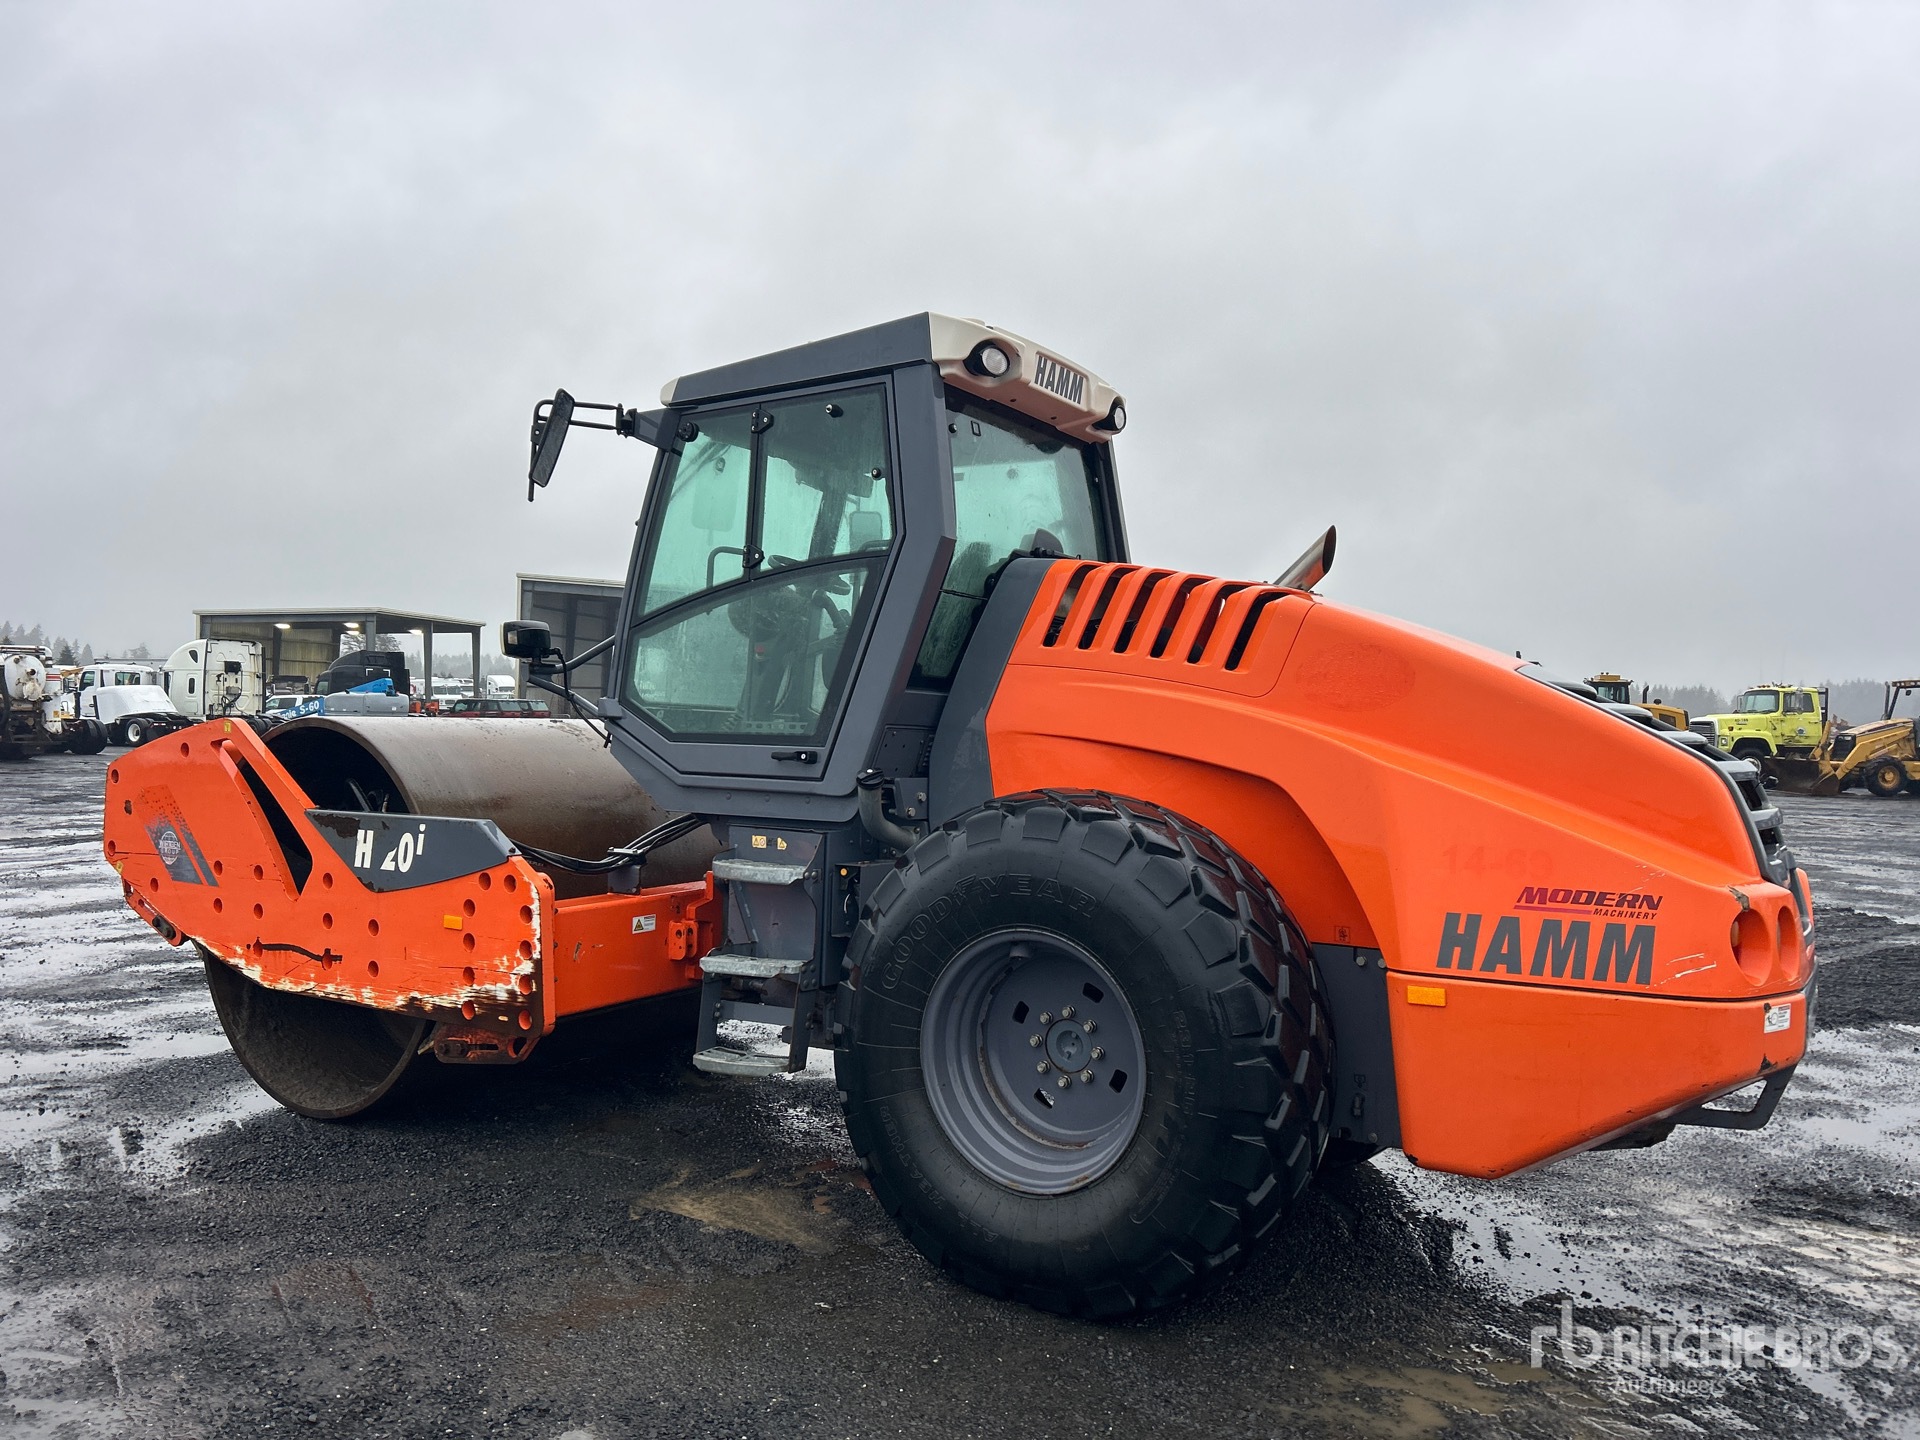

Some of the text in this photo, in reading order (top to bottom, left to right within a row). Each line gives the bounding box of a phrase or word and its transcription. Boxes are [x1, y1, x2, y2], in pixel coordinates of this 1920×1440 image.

[1034, 355, 1084, 405] HAMM
[299, 700, 320, 715] S-60
[354, 829, 374, 869] H
[1516, 886, 1663, 911] MODERN
[1593, 907, 1657, 920] MACHINERY
[881, 873, 1098, 990] GOODYEAR
[1436, 912, 1656, 985] HAMM
